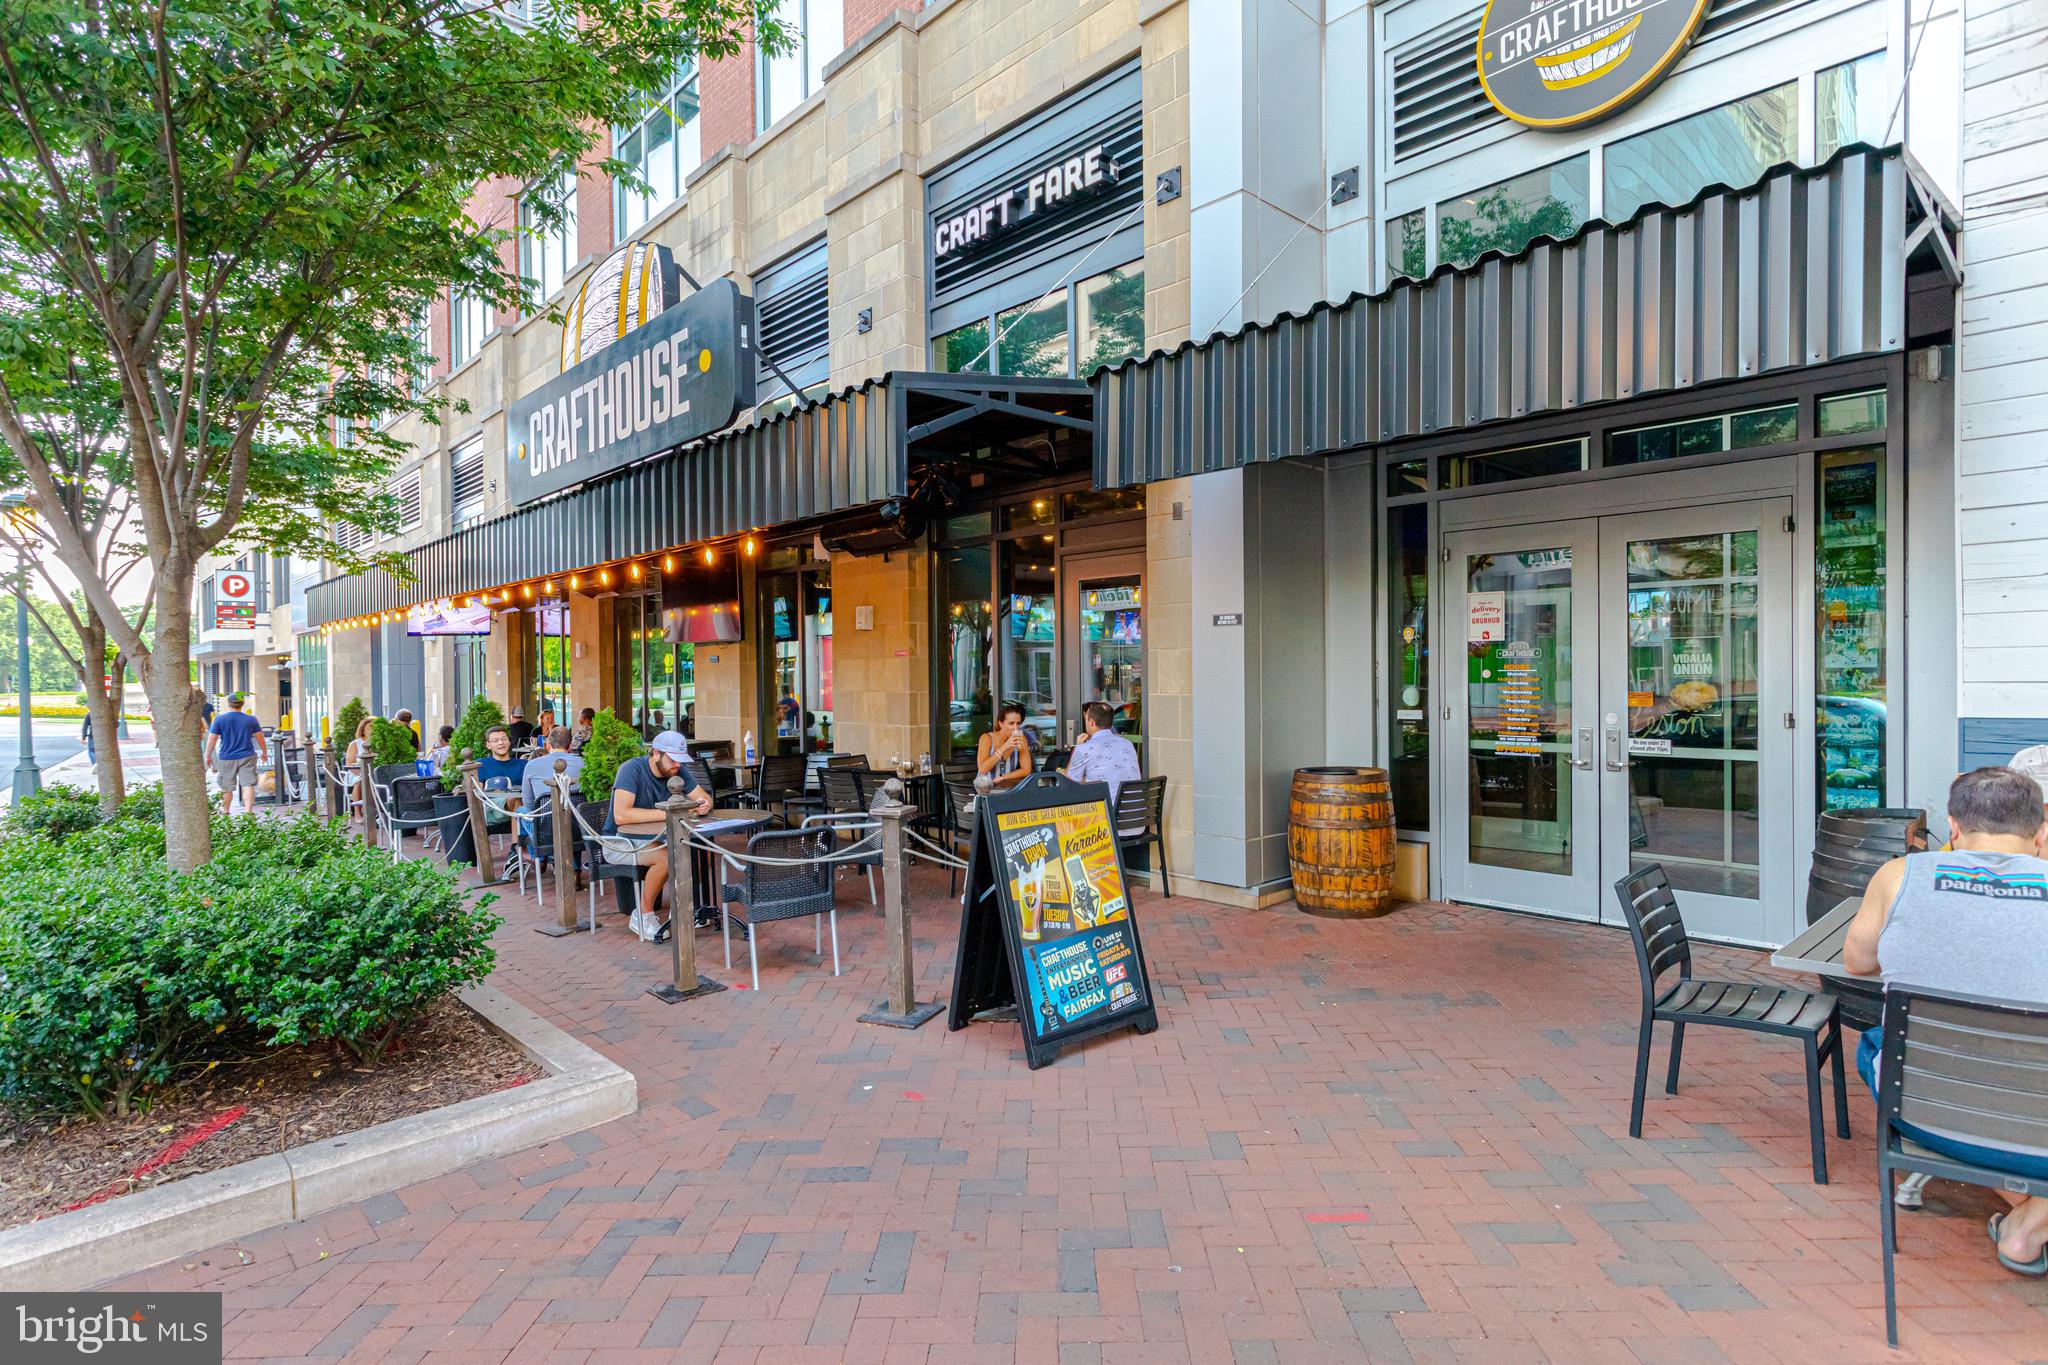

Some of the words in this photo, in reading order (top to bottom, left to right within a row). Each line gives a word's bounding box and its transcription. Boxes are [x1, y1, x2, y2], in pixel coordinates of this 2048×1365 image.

[1500, 0, 1641, 64] CRAFTH
[935, 189, 1014, 255] CRAFT
[1029, 145, 1102, 213] FARE
[529, 328, 690, 477] CRAFTHOUSE
[229, 579, 245, 593] P
[1673, 653, 1713, 663] VIDALIA
[1673, 663, 1713, 675] ONION
[1006, 814, 1019, 826] JOIN
[1020, 813, 1027, 824] US
[1028, 811, 1038, 822] FOR
[1041, 808, 1056, 820] GREAT
[1058, 802, 1098, 817] ENTERTAINMENT
[1003, 830, 1042, 857] CRAFTHOUSE
[1065, 826, 1109, 857] Karaoke
[1080, 841, 1112, 861] Wednesdays
[1021, 842, 1048, 865] TRIVIA
[1045, 880, 1061, 891] TRIVIA
[1940, 878, 2042, 898] patagonia
[1045, 891, 1061, 901] KINGS
[1043, 908, 1069, 922] TUESDAY
[1103, 933, 1115, 943] LIVE
[1041, 940, 1089, 967] CRAFTHOUSE
[1097, 944, 1119, 960] FRIDAYS
[1099, 947, 1132, 967] SATURDAYS
[1046, 952, 1092, 974] ENTERTAINMENT
[1047, 958, 1097, 990] MUSIC
[1106, 965, 1125, 982] UFC
[1059, 989, 1069, 1004] &
[1068, 975, 1101, 999] BEER
[1064, 988, 1106, 1018] FAIRFAX
[1111, 992, 1138, 1011] CRAFTHOUSE
